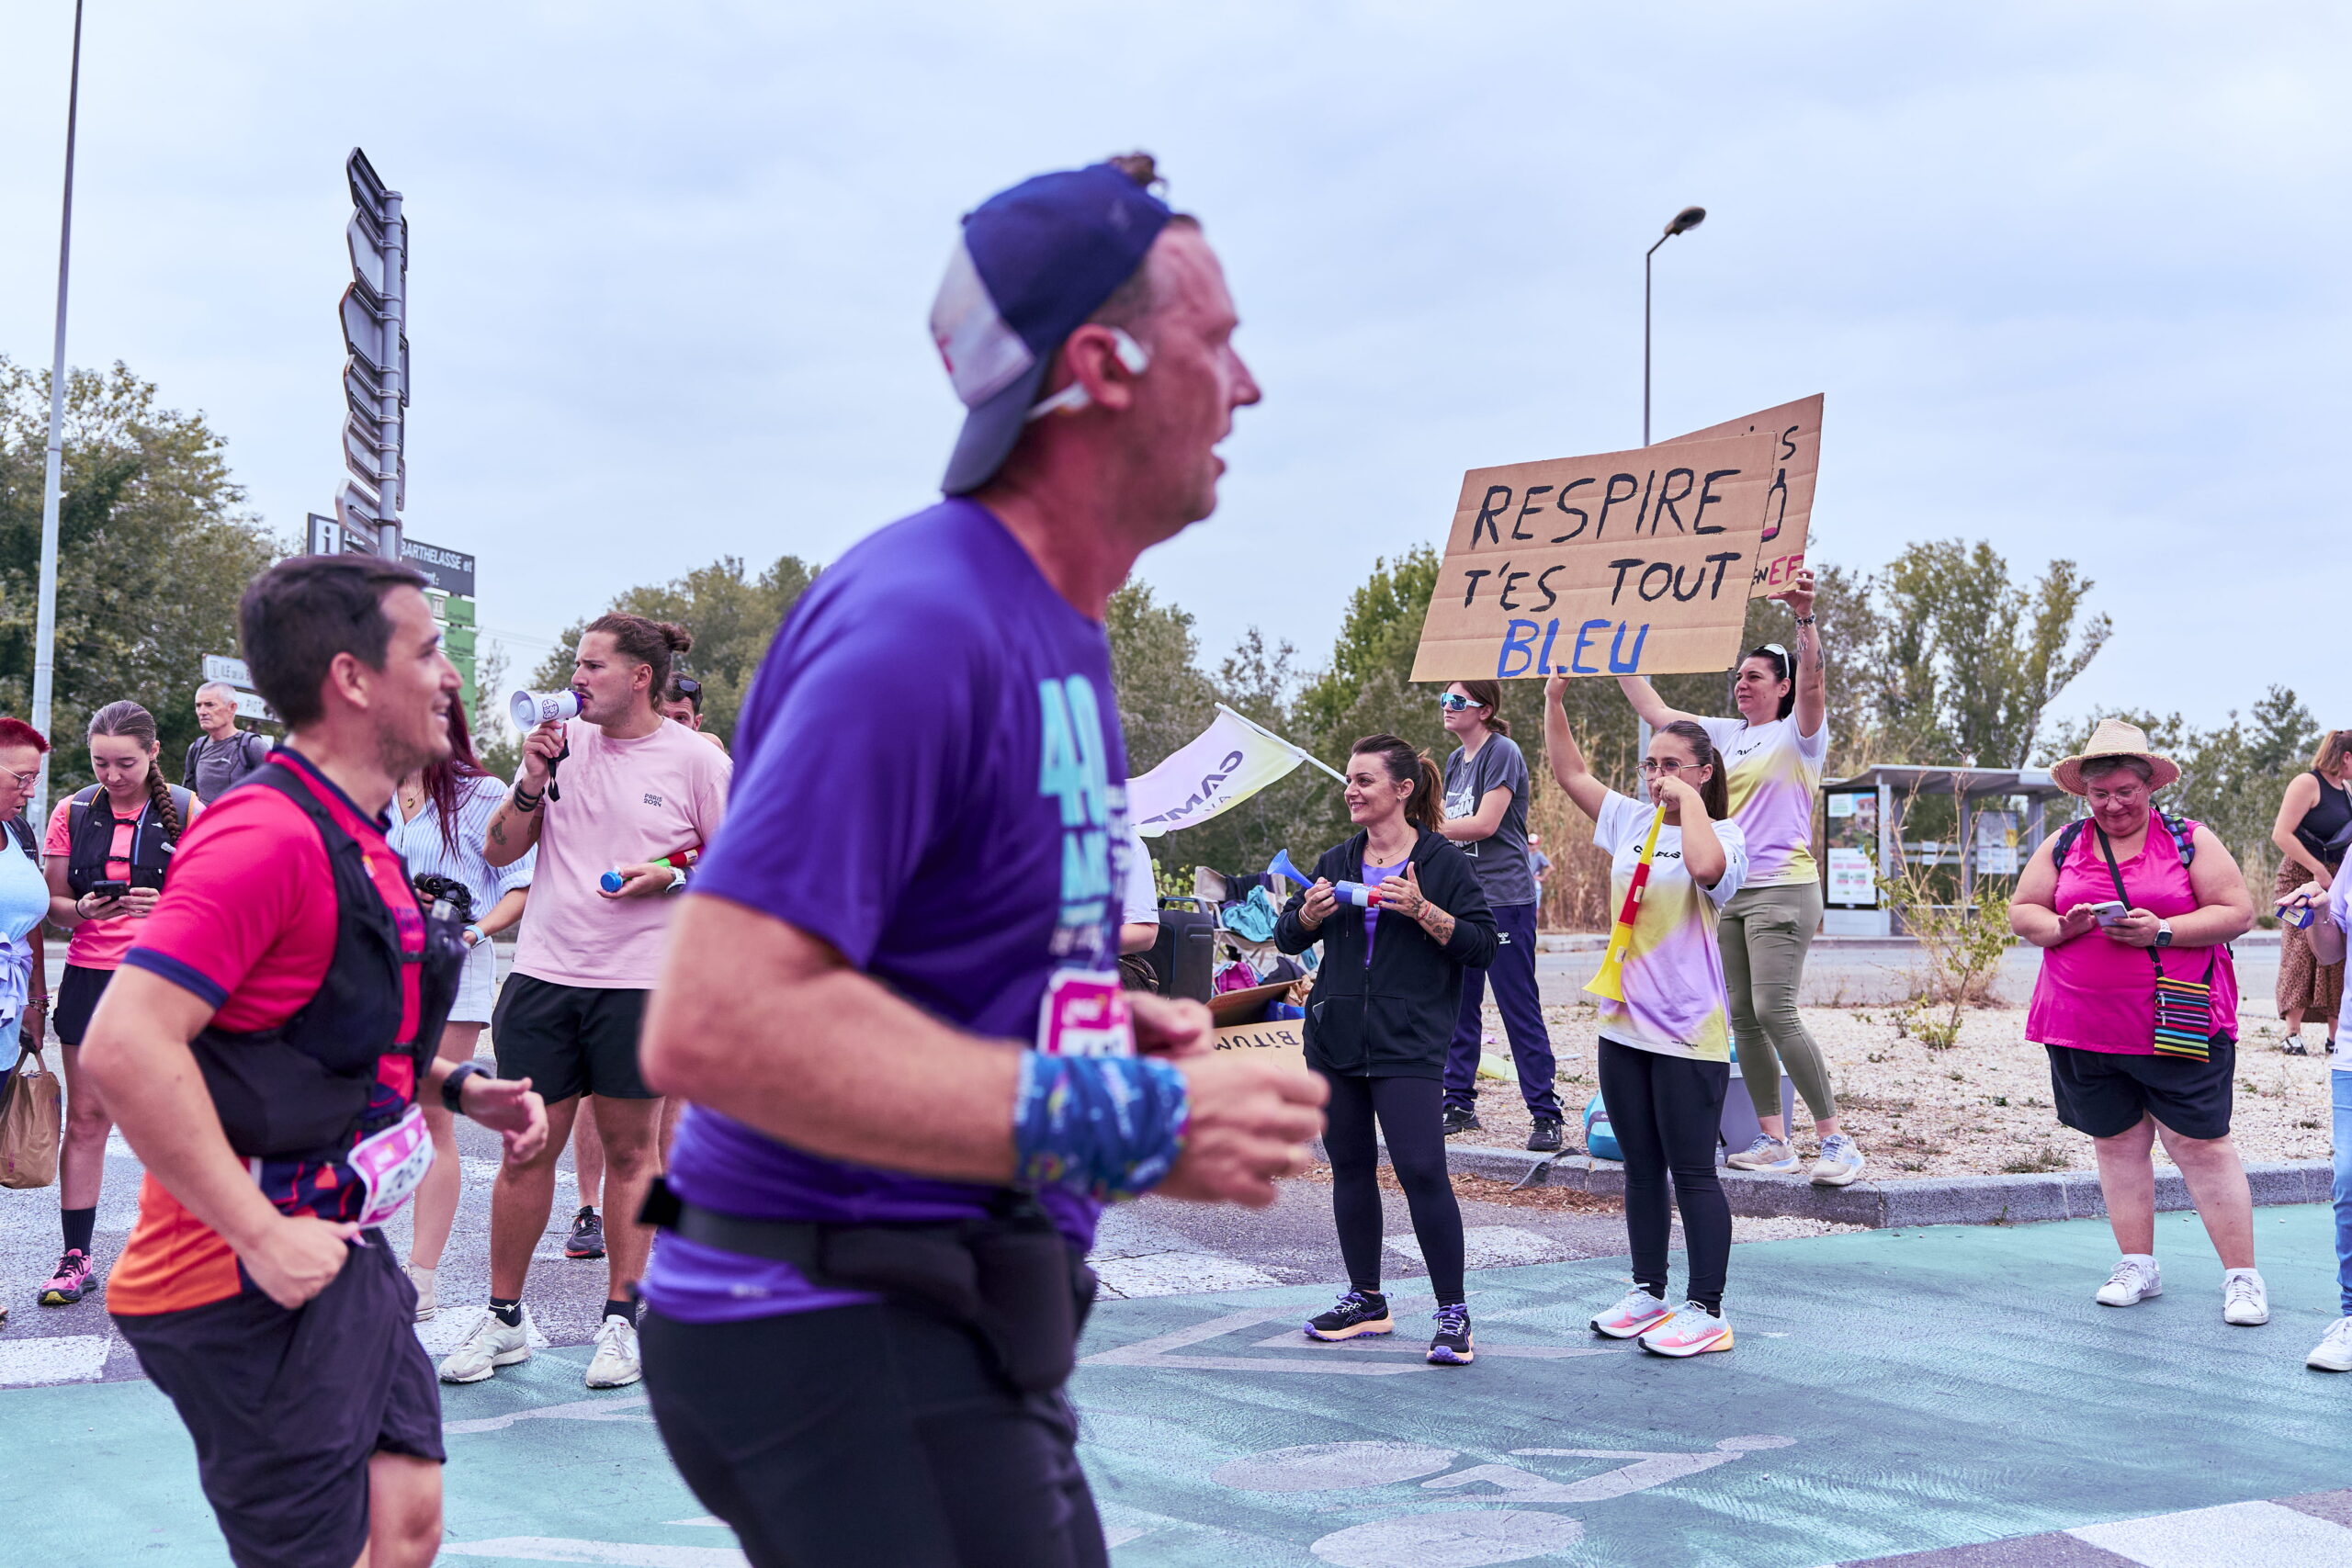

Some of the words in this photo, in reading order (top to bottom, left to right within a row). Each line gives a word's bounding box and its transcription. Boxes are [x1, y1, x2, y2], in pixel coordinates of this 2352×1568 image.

[1470, 468, 1742, 550] RESPIRE
[1464, 559, 1566, 612] T'ES
[1608, 551, 1742, 605] TOUT
[1497, 617, 1650, 679] BLEU
[643, 798, 662, 807] 2024
[644, 793, 662, 803] PARIS
